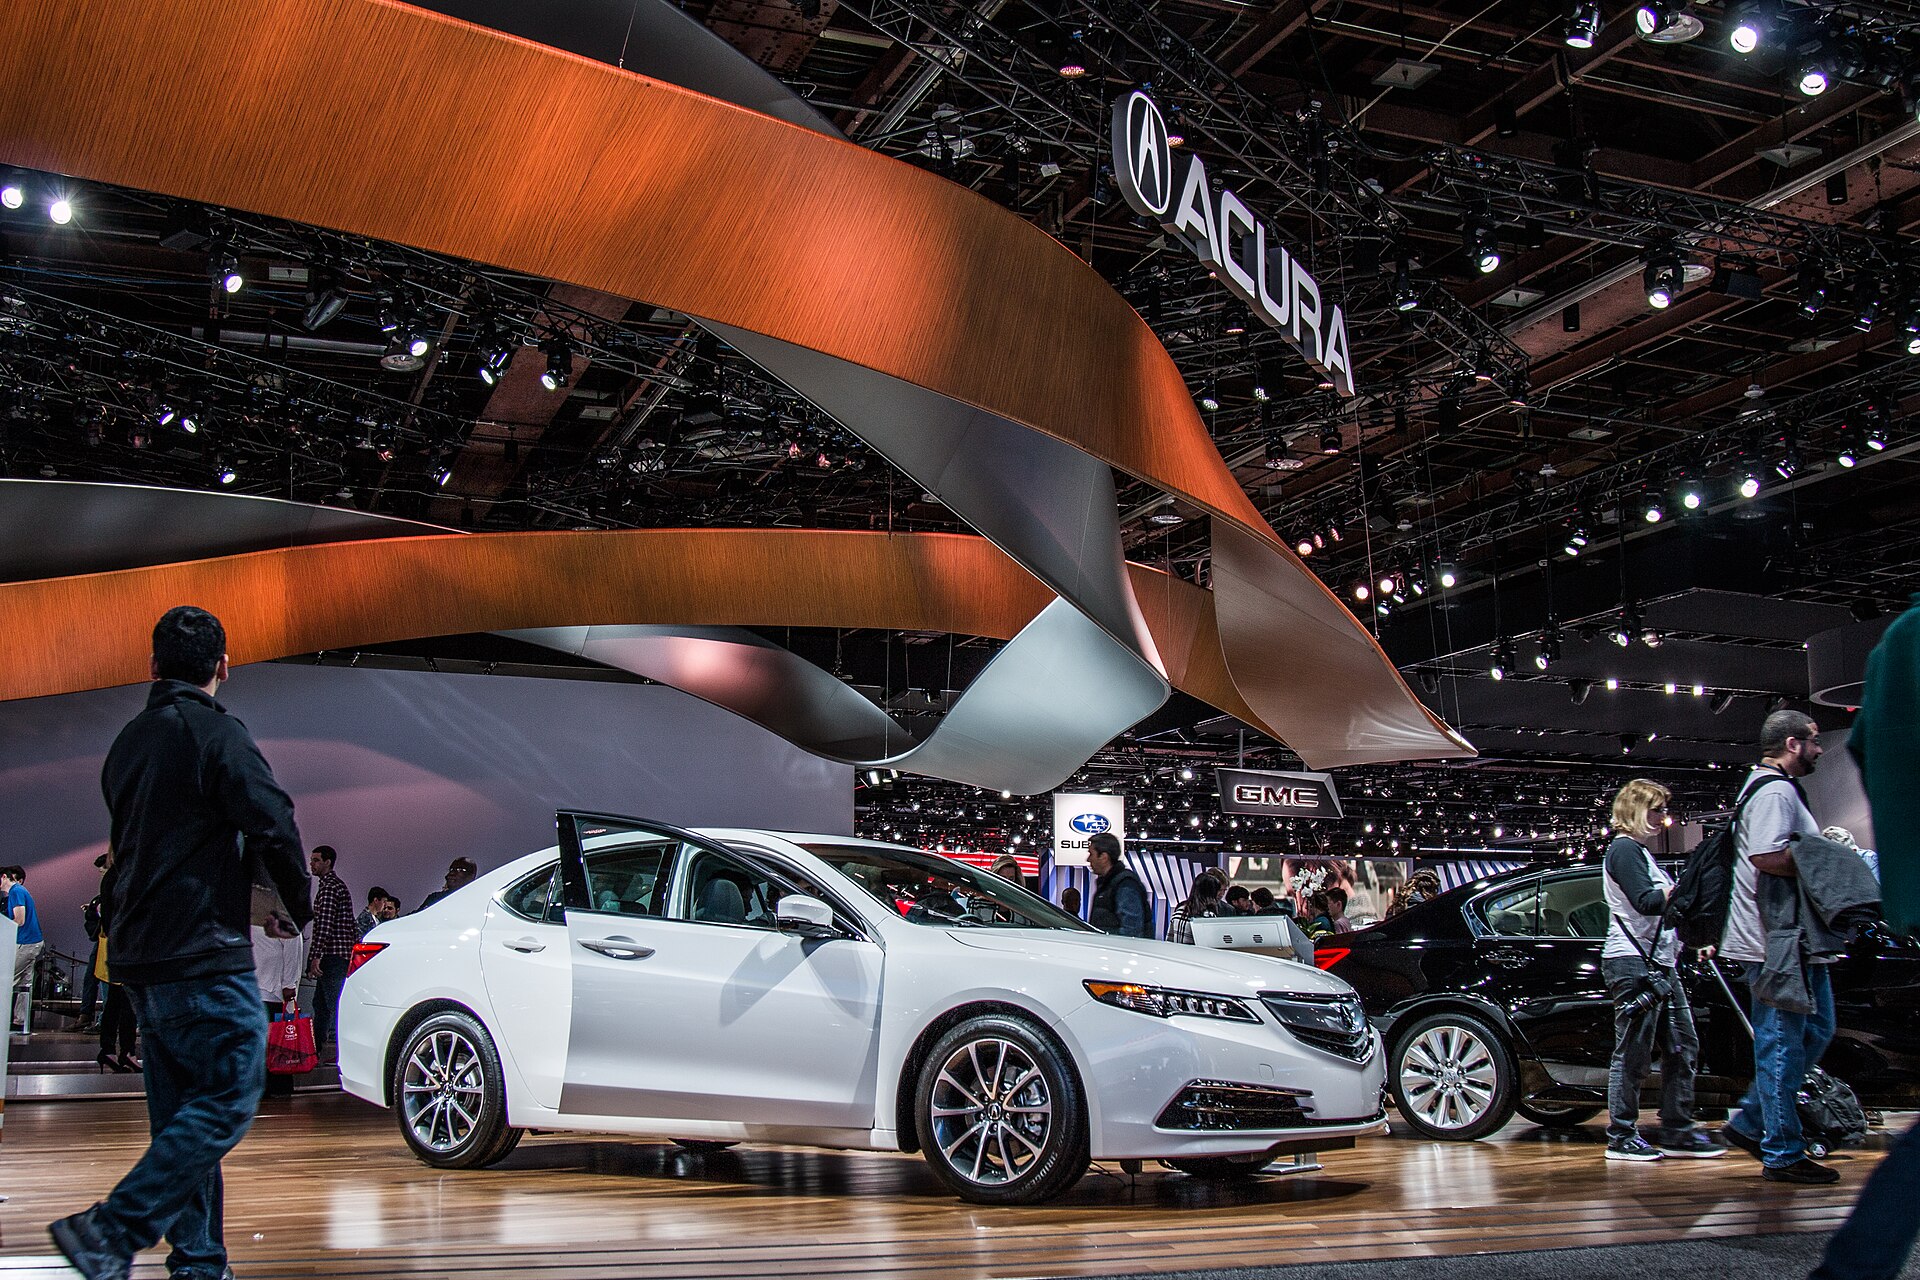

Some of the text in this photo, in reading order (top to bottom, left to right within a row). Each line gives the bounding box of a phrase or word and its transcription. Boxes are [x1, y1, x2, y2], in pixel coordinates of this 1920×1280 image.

[1174, 154, 1355, 396] ACURA
[1234, 784, 1319, 808] GMC
[1060, 840, 1090, 849] SUB
